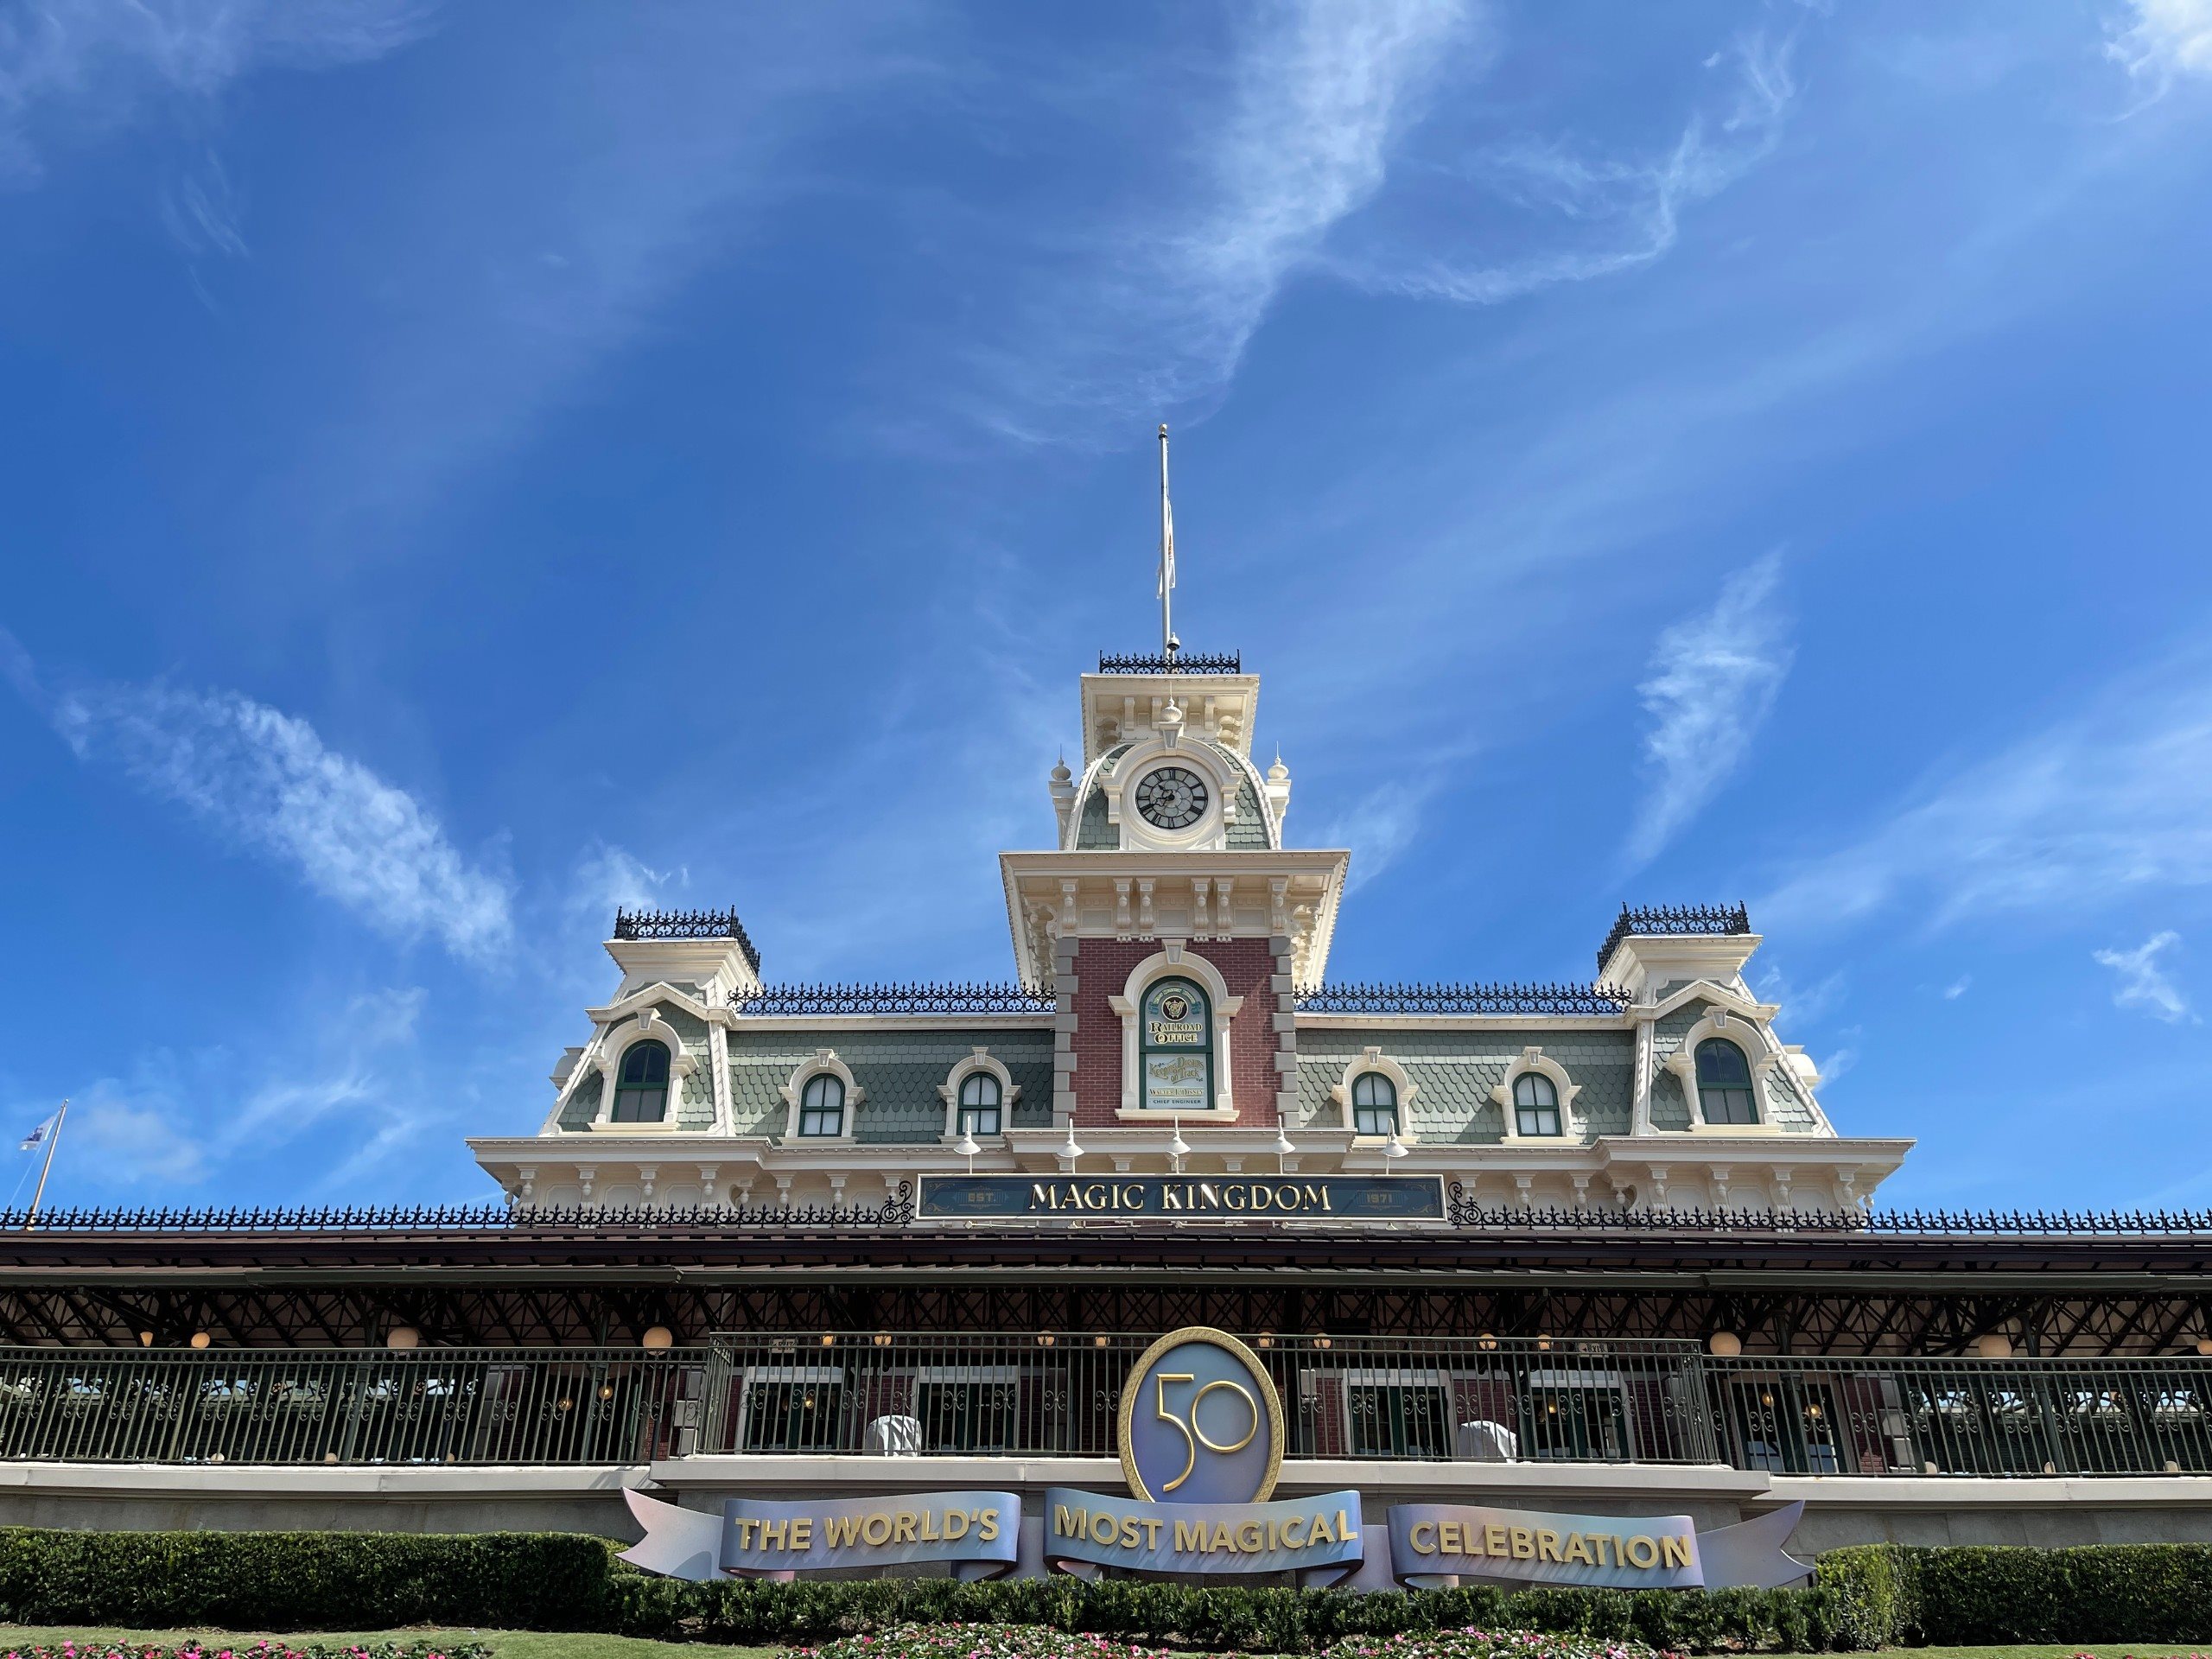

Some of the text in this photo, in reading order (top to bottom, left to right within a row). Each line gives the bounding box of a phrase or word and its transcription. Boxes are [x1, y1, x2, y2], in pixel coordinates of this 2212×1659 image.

[1148, 1020, 1203, 1033] RAILROAD
[1154, 1033, 1198, 1045] OFFICE
[1028, 1184, 1332, 1211] MAGIC KINGDOM
[1366, 1192, 1393, 1204] 1971
[1156, 1373, 1258, 1492] 50
[735, 1508, 1000, 1551] THE WORLD'S
[1054, 1503, 1358, 1554] MOST MAGICAL
[1409, 1521, 1693, 1569] CELEBRATION
